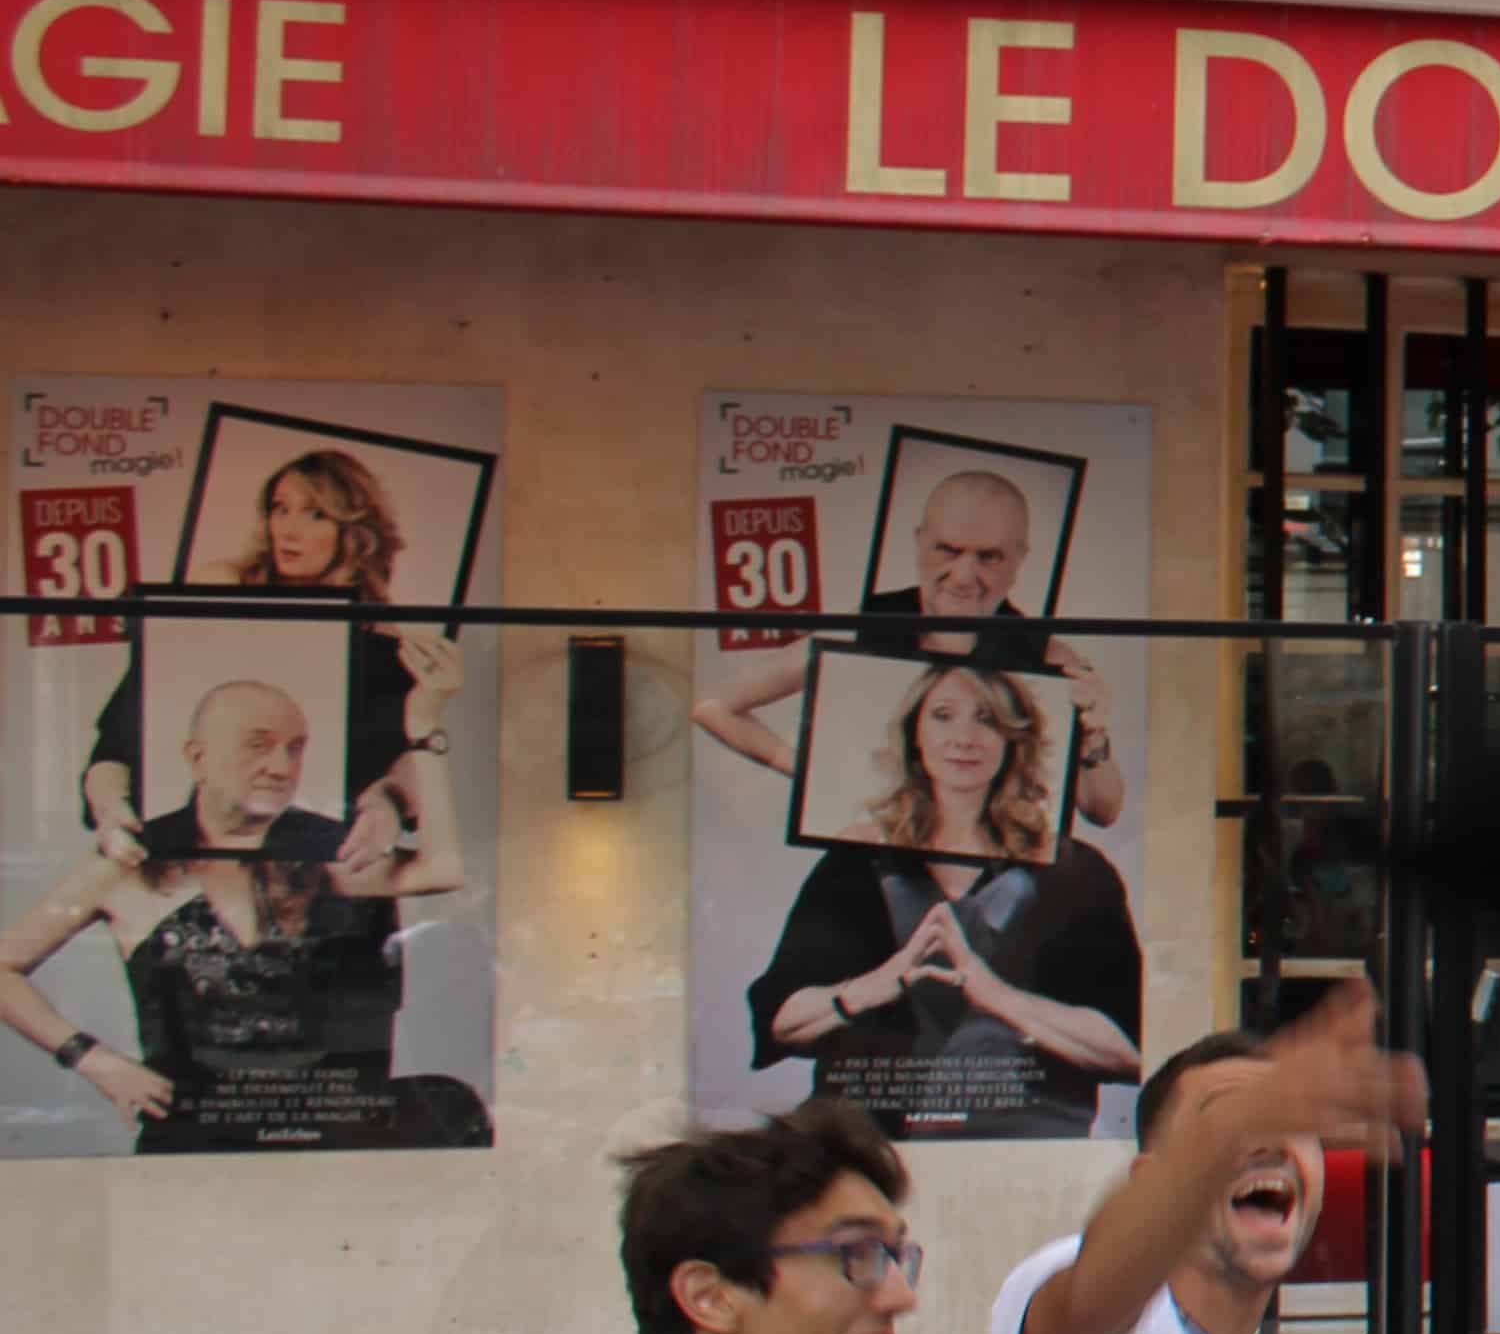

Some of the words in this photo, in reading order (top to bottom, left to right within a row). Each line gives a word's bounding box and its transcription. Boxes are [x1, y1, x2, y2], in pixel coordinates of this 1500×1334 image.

[845, 11, 1075, 203] LE
[37, 406, 157, 432] DOUBLE
[731, 414, 841, 440] DOUBLE
[37, 431, 127, 457] FOND
[731, 439, 814, 464] FOND
[35, 496, 122, 526] DEPUIS
[723, 508, 805, 535] DEPUIS
[36, 529, 128, 601] 30
[726, 538, 809, 608] 30
